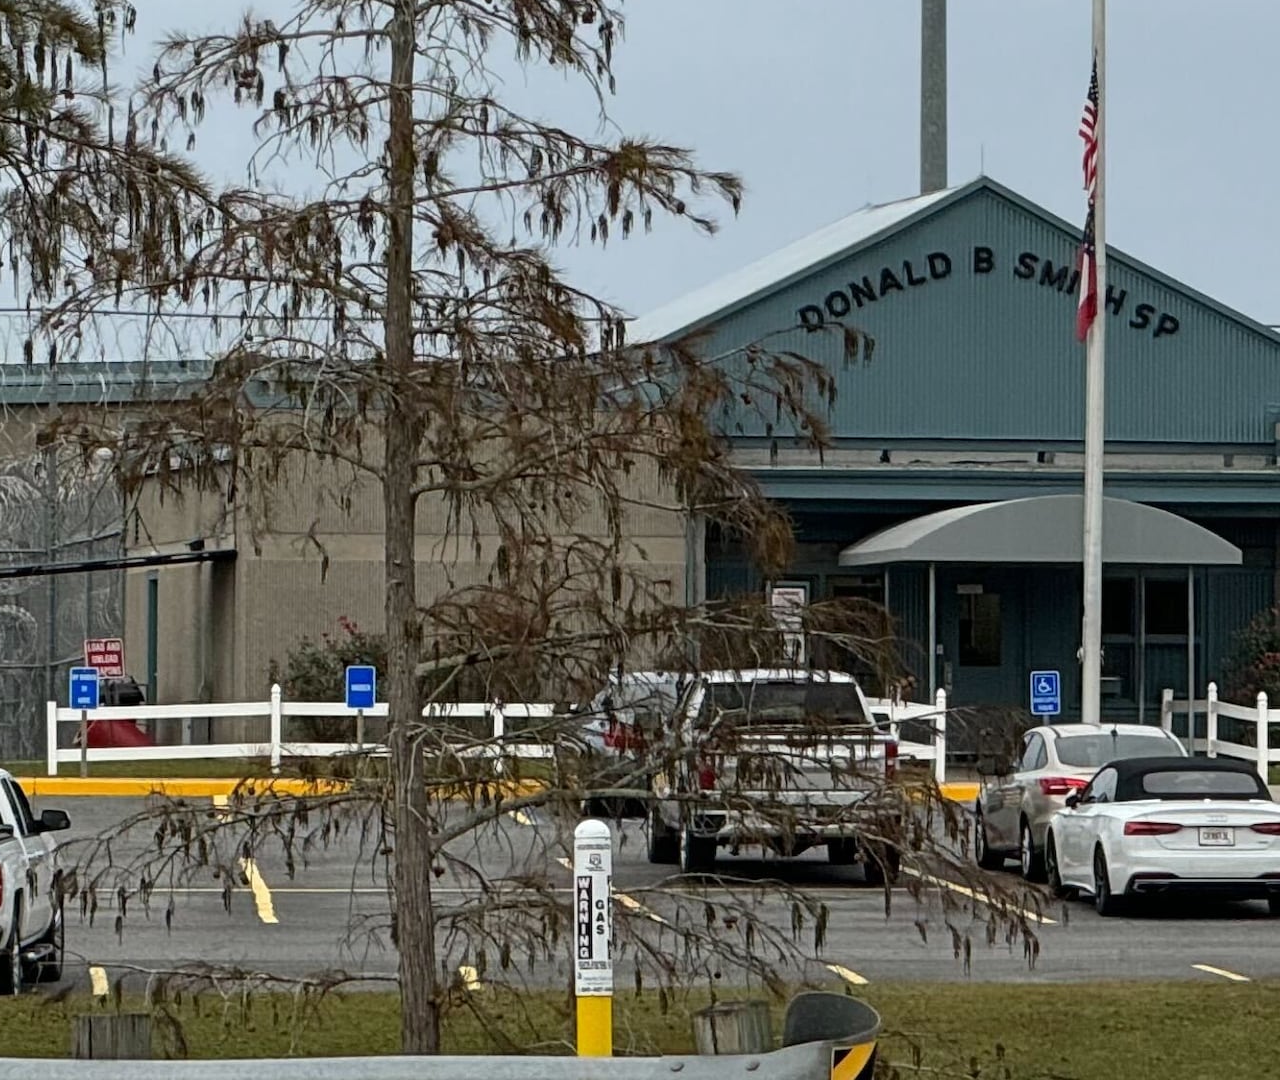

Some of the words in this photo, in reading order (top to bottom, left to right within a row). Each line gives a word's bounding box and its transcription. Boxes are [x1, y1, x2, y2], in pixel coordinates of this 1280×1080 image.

[797, 251, 952, 333] DONALD
[973, 246, 994, 273] B
[1013, 252, 1127, 316] SMIH
[1129, 303, 1180, 338] SP
[578, 877, 590, 958] WARNING
[595, 899, 605, 935] GAS
